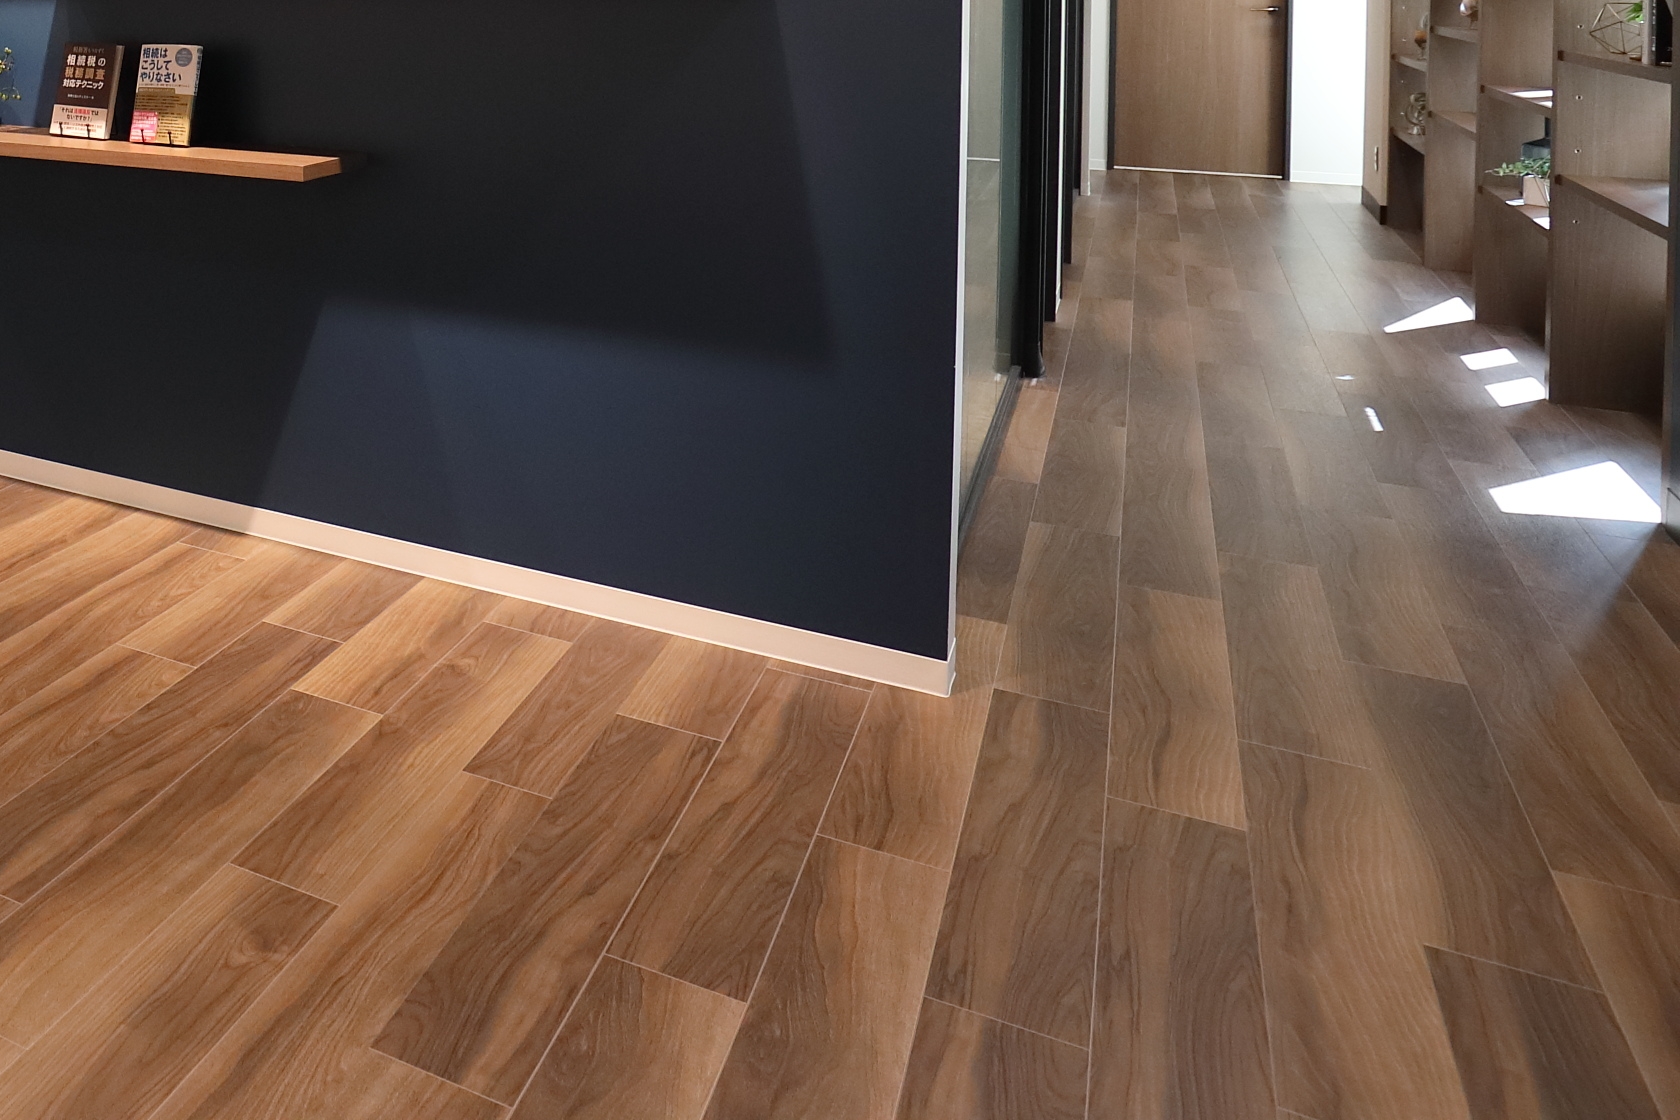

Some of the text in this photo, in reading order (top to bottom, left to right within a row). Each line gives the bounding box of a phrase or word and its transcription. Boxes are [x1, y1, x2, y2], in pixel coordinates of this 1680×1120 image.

[143, 48, 168, 59] 相続は
[66, 53, 106, 67] 相続税の
[141, 60, 172, 71] こうして
[64, 67, 105, 80] 税務調査
[140, 72, 182, 83] やりなさい
[62, 79, 104, 90] 対応テクニック
